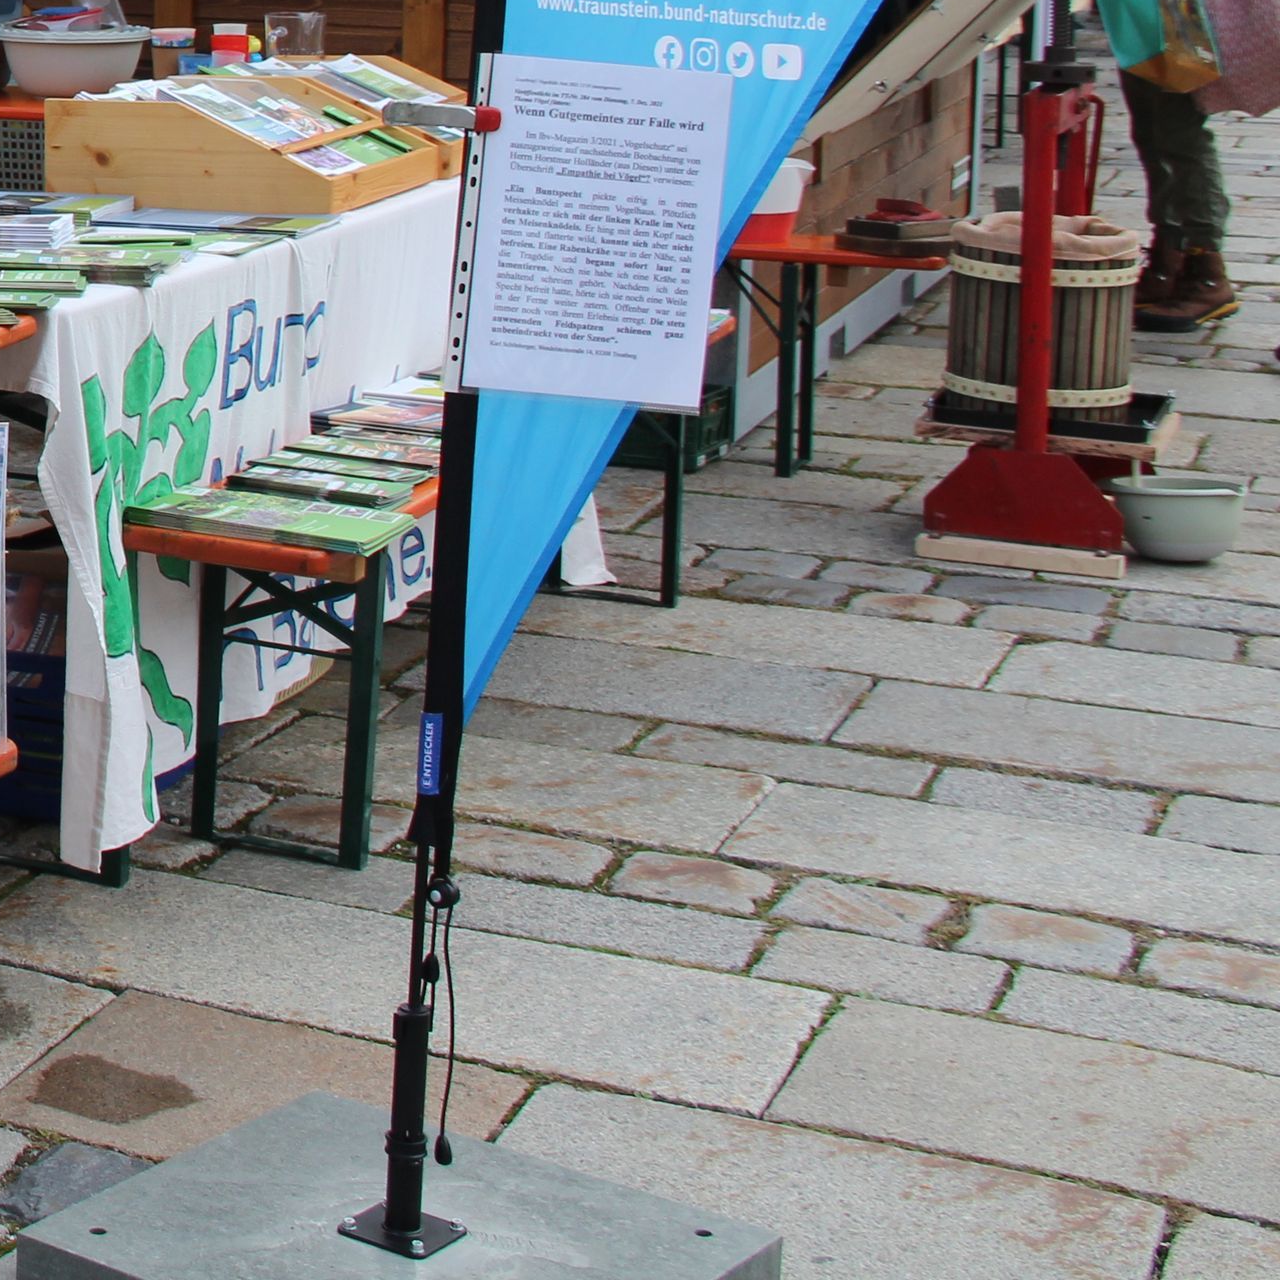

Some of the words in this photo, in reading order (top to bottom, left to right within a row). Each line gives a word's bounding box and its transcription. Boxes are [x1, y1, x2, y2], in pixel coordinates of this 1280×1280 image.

[514, 105, 545, 116] Wenn
[548, 108, 624, 123] Gutgemeintes
[648, 117, 675, 128] Falle
[678, 120, 704, 131] wird
[422, 721, 434, 789] ENTDECKER
